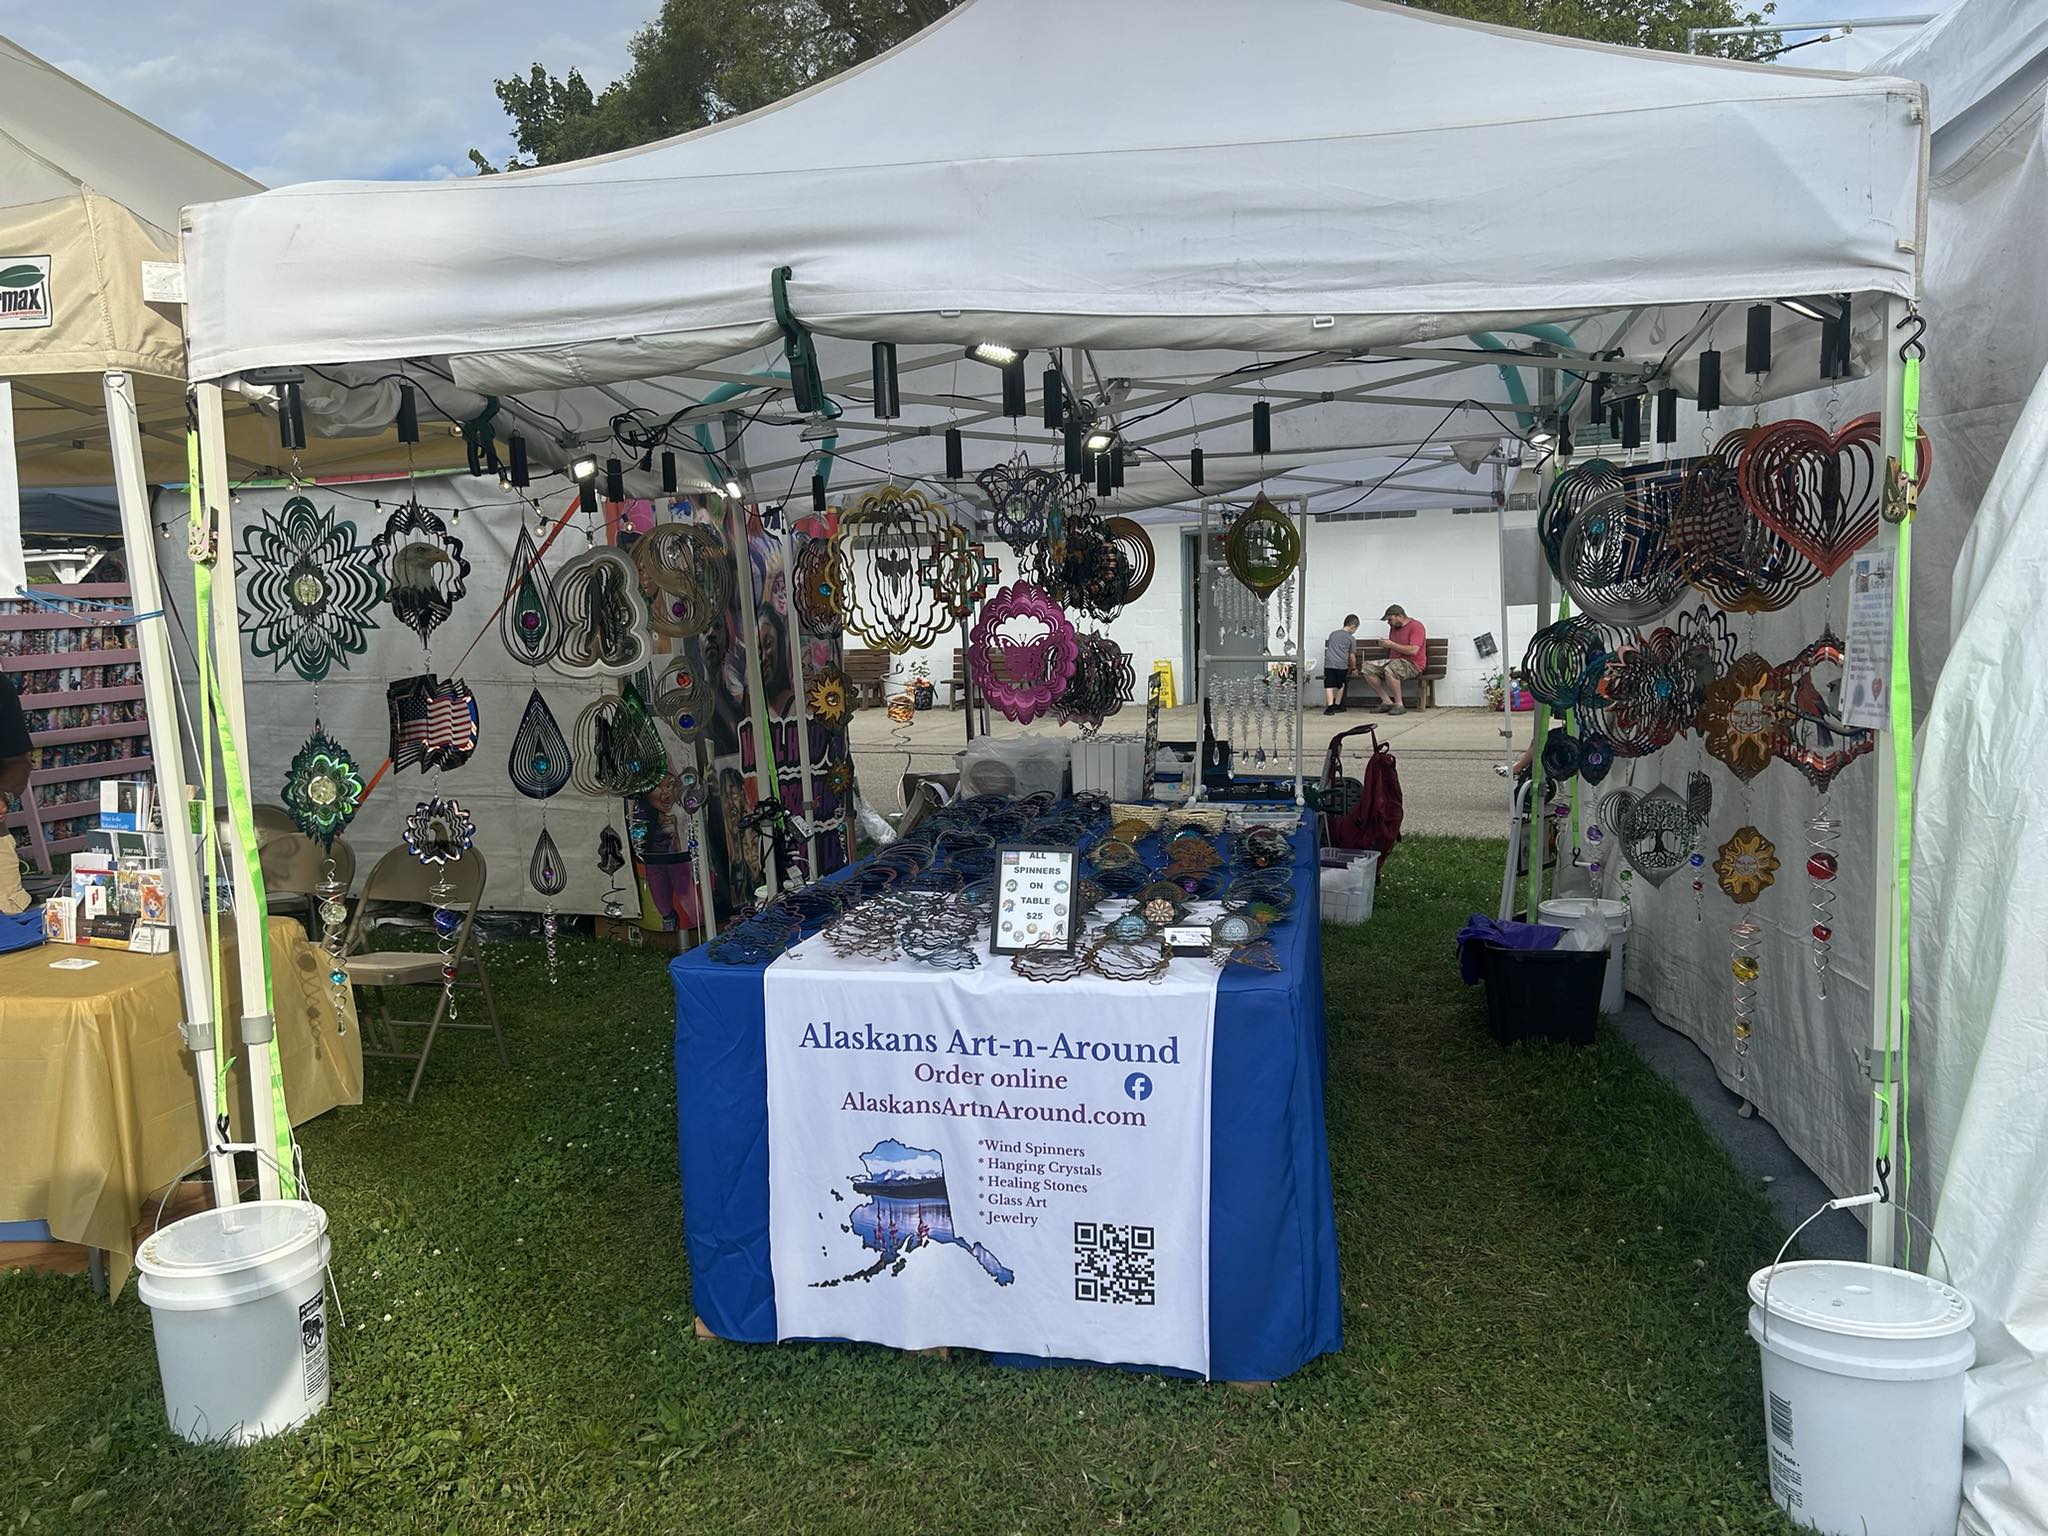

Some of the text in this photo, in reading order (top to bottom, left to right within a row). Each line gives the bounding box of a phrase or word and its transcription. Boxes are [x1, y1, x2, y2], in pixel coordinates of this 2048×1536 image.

[0, 288, 42, 313] max
[1013, 866, 1061, 875] SPINNERS
[1029, 881, 1043, 890] ON
[1020, 896, 1051, 905] TABLE
[1026, 912, 1043, 920] $25
[799, 1022, 1181, 1065] Alaskans Art-n-Around
[914, 1063, 1068, 1090] Order online
[840, 1091, 1148, 1128] AlaskansArtnAround.com
[1025, 1142, 1086, 1158] Spinners
[987, 1157, 1103, 1177] Hanging Crystals
[987, 1175, 1088, 1194] Healing Stones
[987, 1193, 1048, 1209] Glass Art
[986, 1211, 1039, 1229] Jewelry
